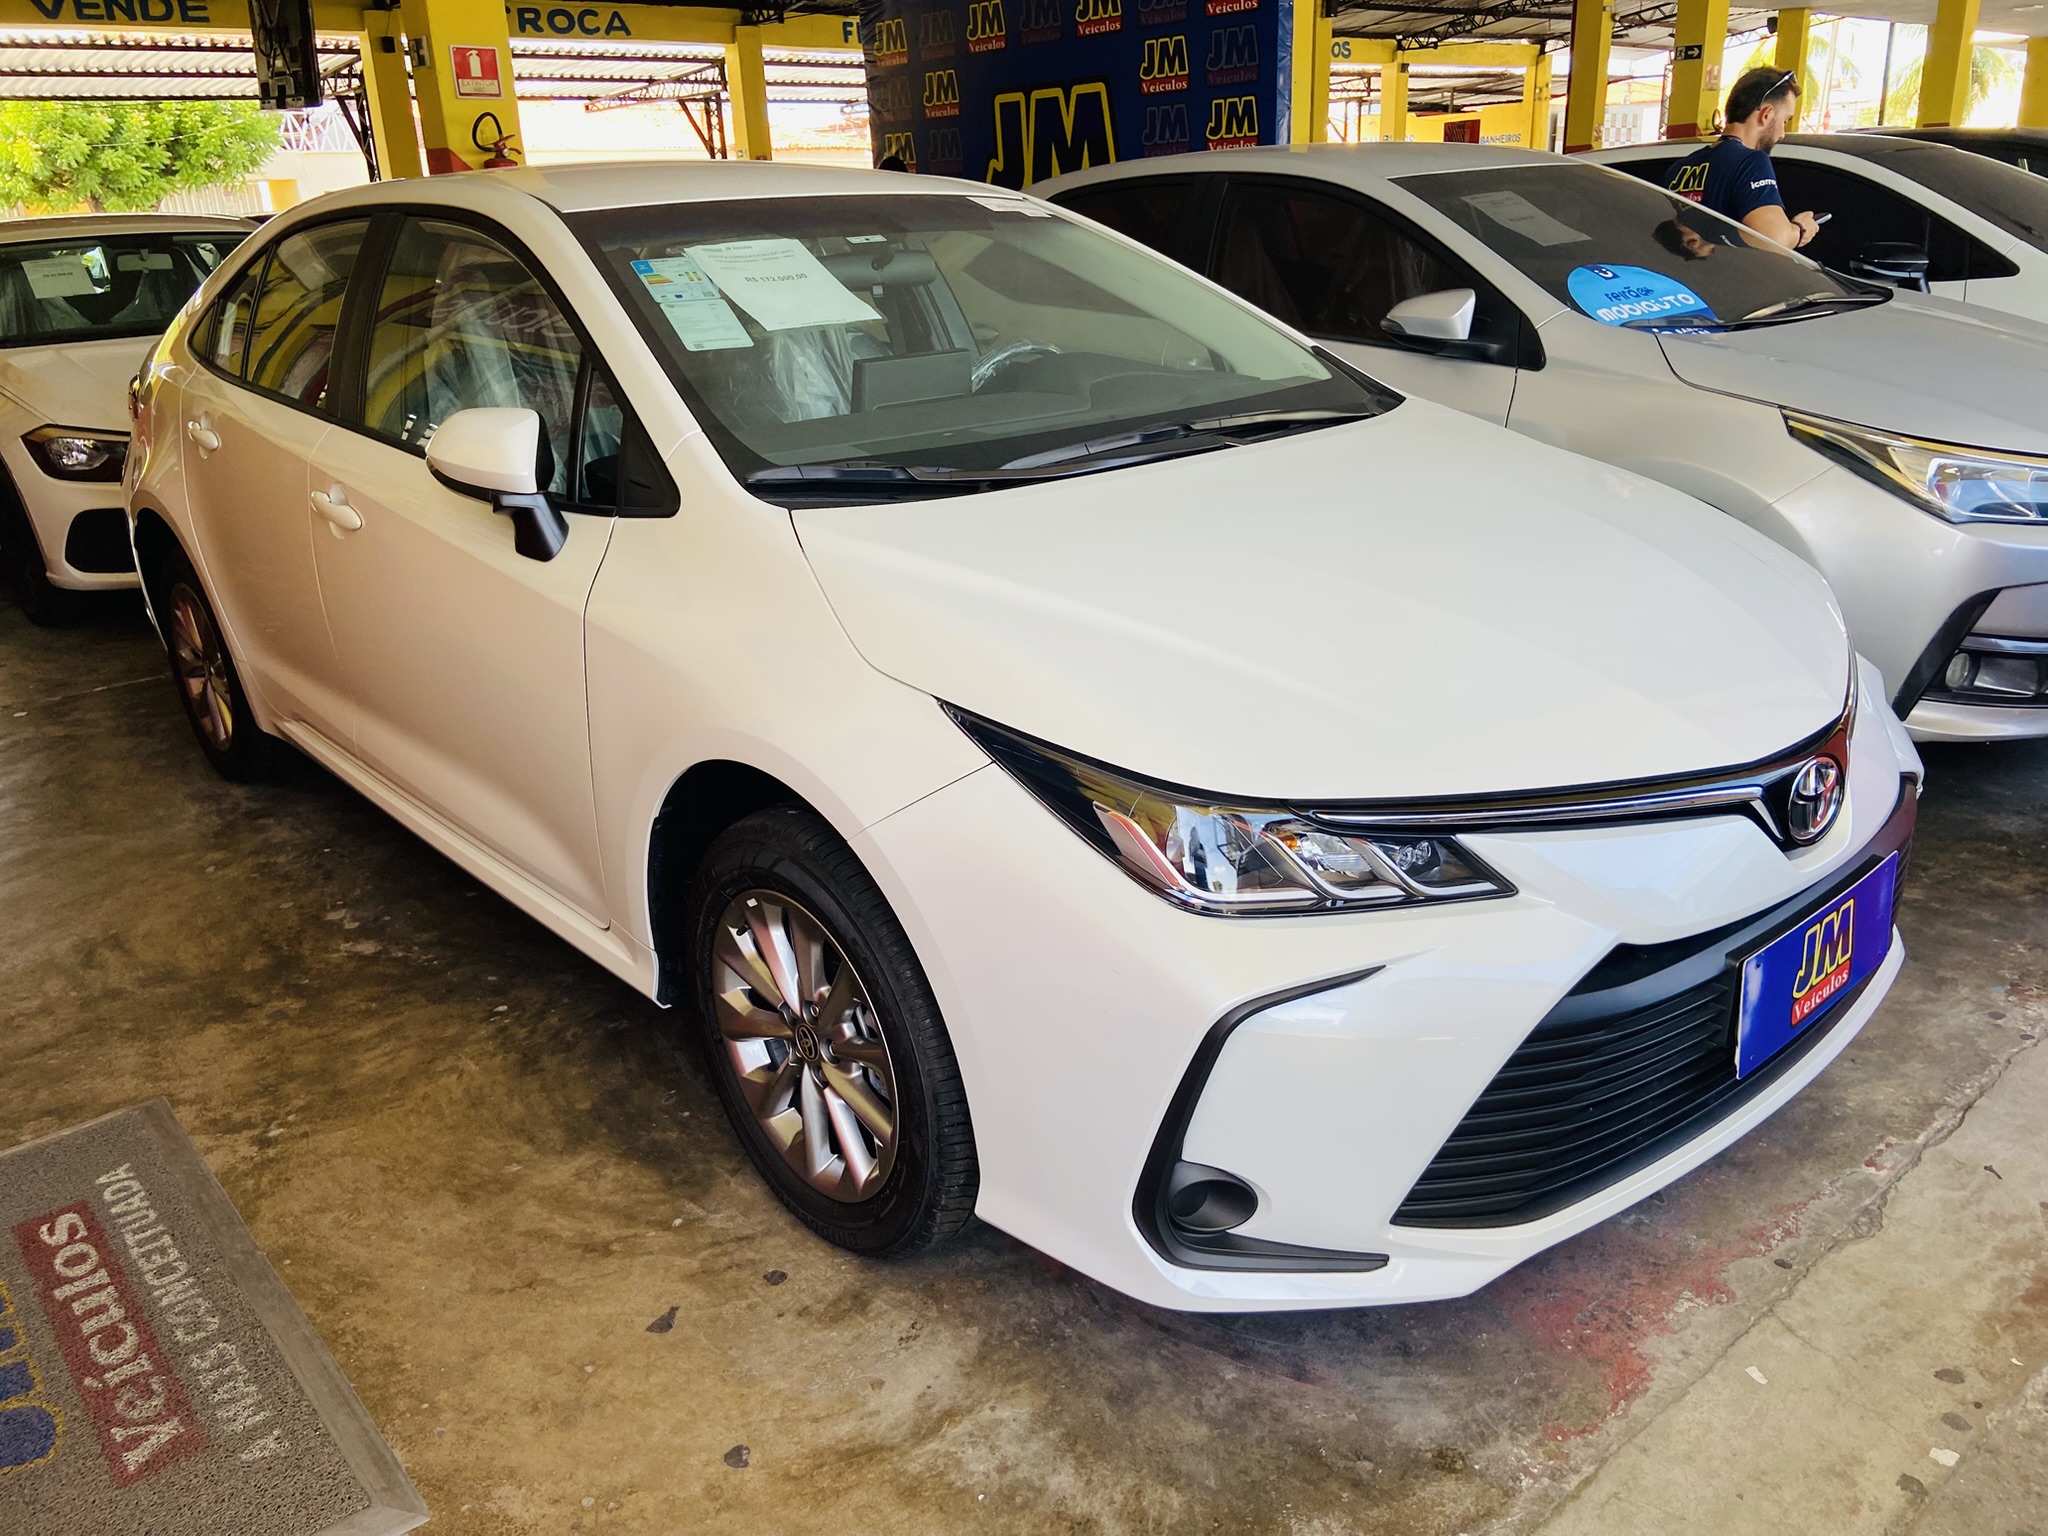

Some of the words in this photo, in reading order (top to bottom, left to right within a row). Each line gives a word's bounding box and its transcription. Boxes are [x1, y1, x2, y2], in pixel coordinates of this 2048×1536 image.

[28, 0, 210, 23] VENDE
[505, 5, 632, 36] ROCA
[965, 0, 1007, 41] JM
[874, 18, 908, 56] JM
[1140, 35, 1189, 80] JM
[1206, 24, 1259, 71] JM
[923, 69, 960, 106] JM
[986, 82, 1121, 190] JM
[1142, 104, 1189, 145] JM
[1206, 96, 1258, 139] JM
[1480, 133, 1522, 145] BANHEIROS
[1669, 162, 1710, 192] JM
[1793, 898, 1854, 999] JM
[1794, 966, 1850, 1021] Veículos
[95, 1162, 220, 1344] CONCEITUADA
[39, 1211, 186, 1472] Veículos
